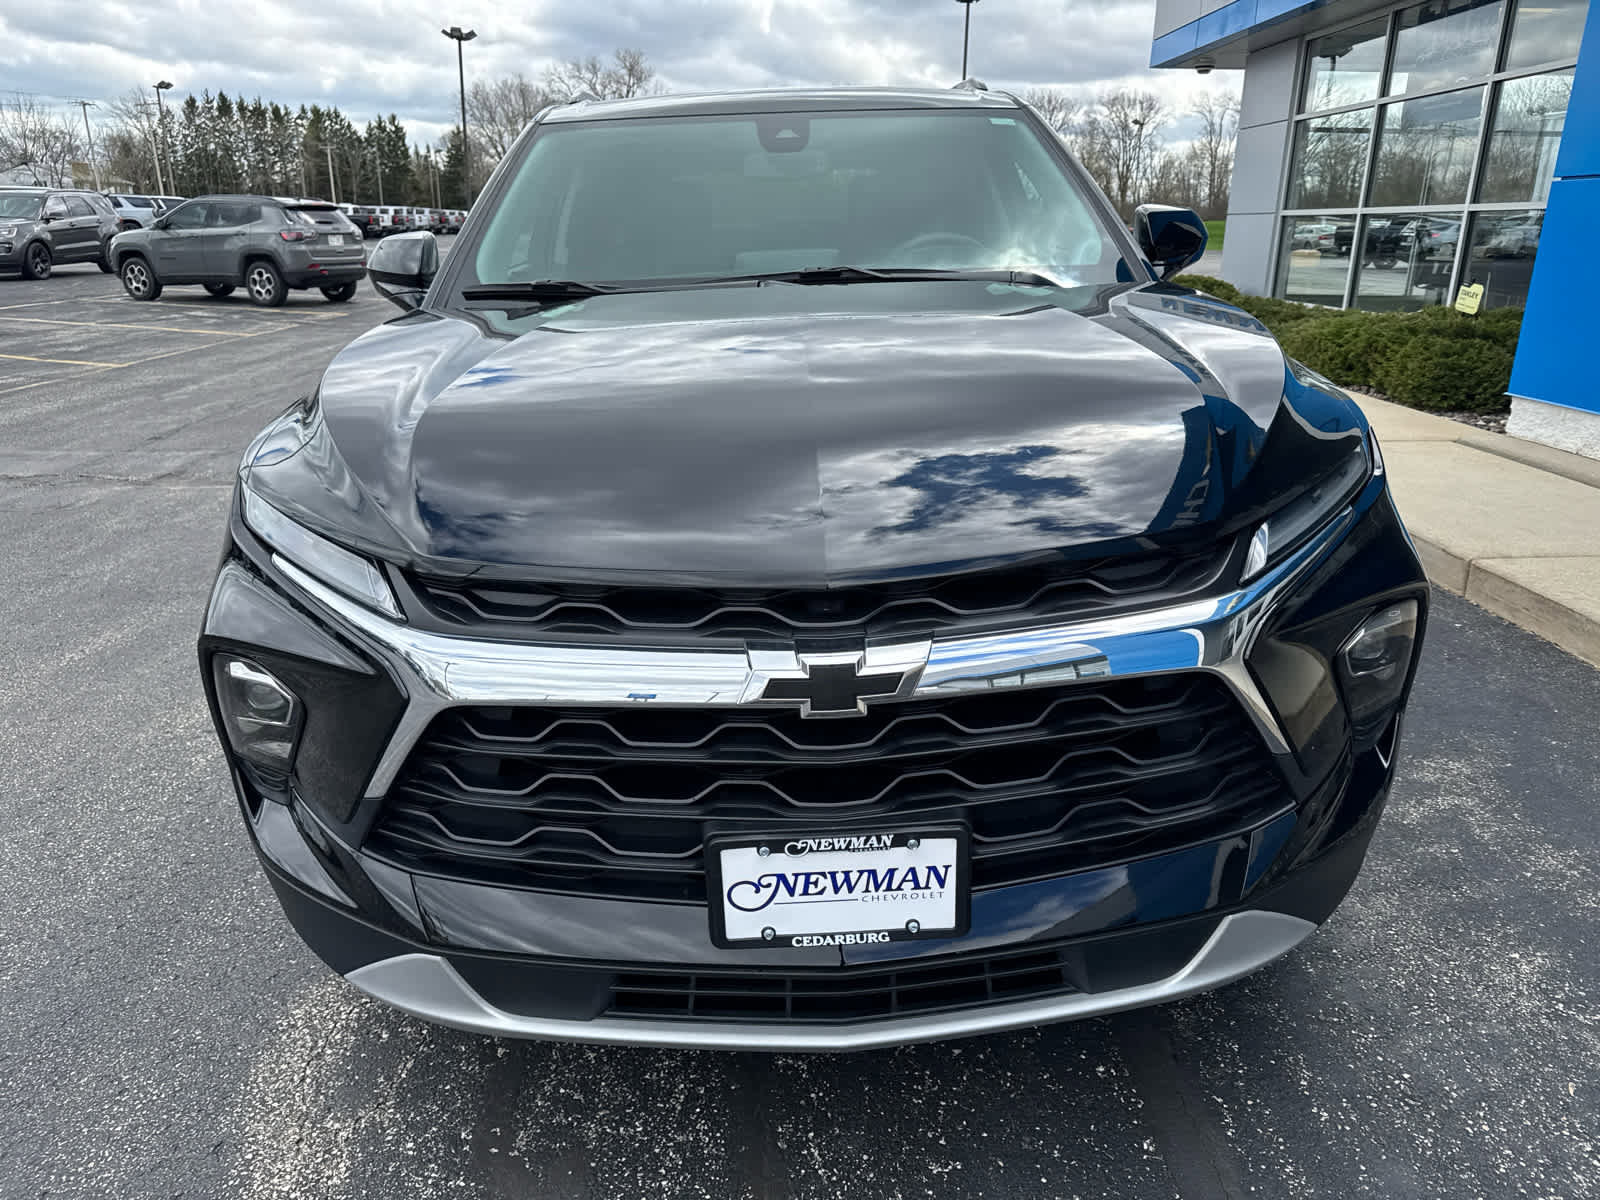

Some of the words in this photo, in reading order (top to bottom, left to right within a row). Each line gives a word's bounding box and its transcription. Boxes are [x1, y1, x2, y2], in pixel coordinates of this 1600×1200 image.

[785, 834, 894, 857] NEWMAN
[727, 864, 952, 912] NEWMAN
[861, 891, 945, 903] CHEVROLET
[791, 932, 890, 948] CEDARBURG
